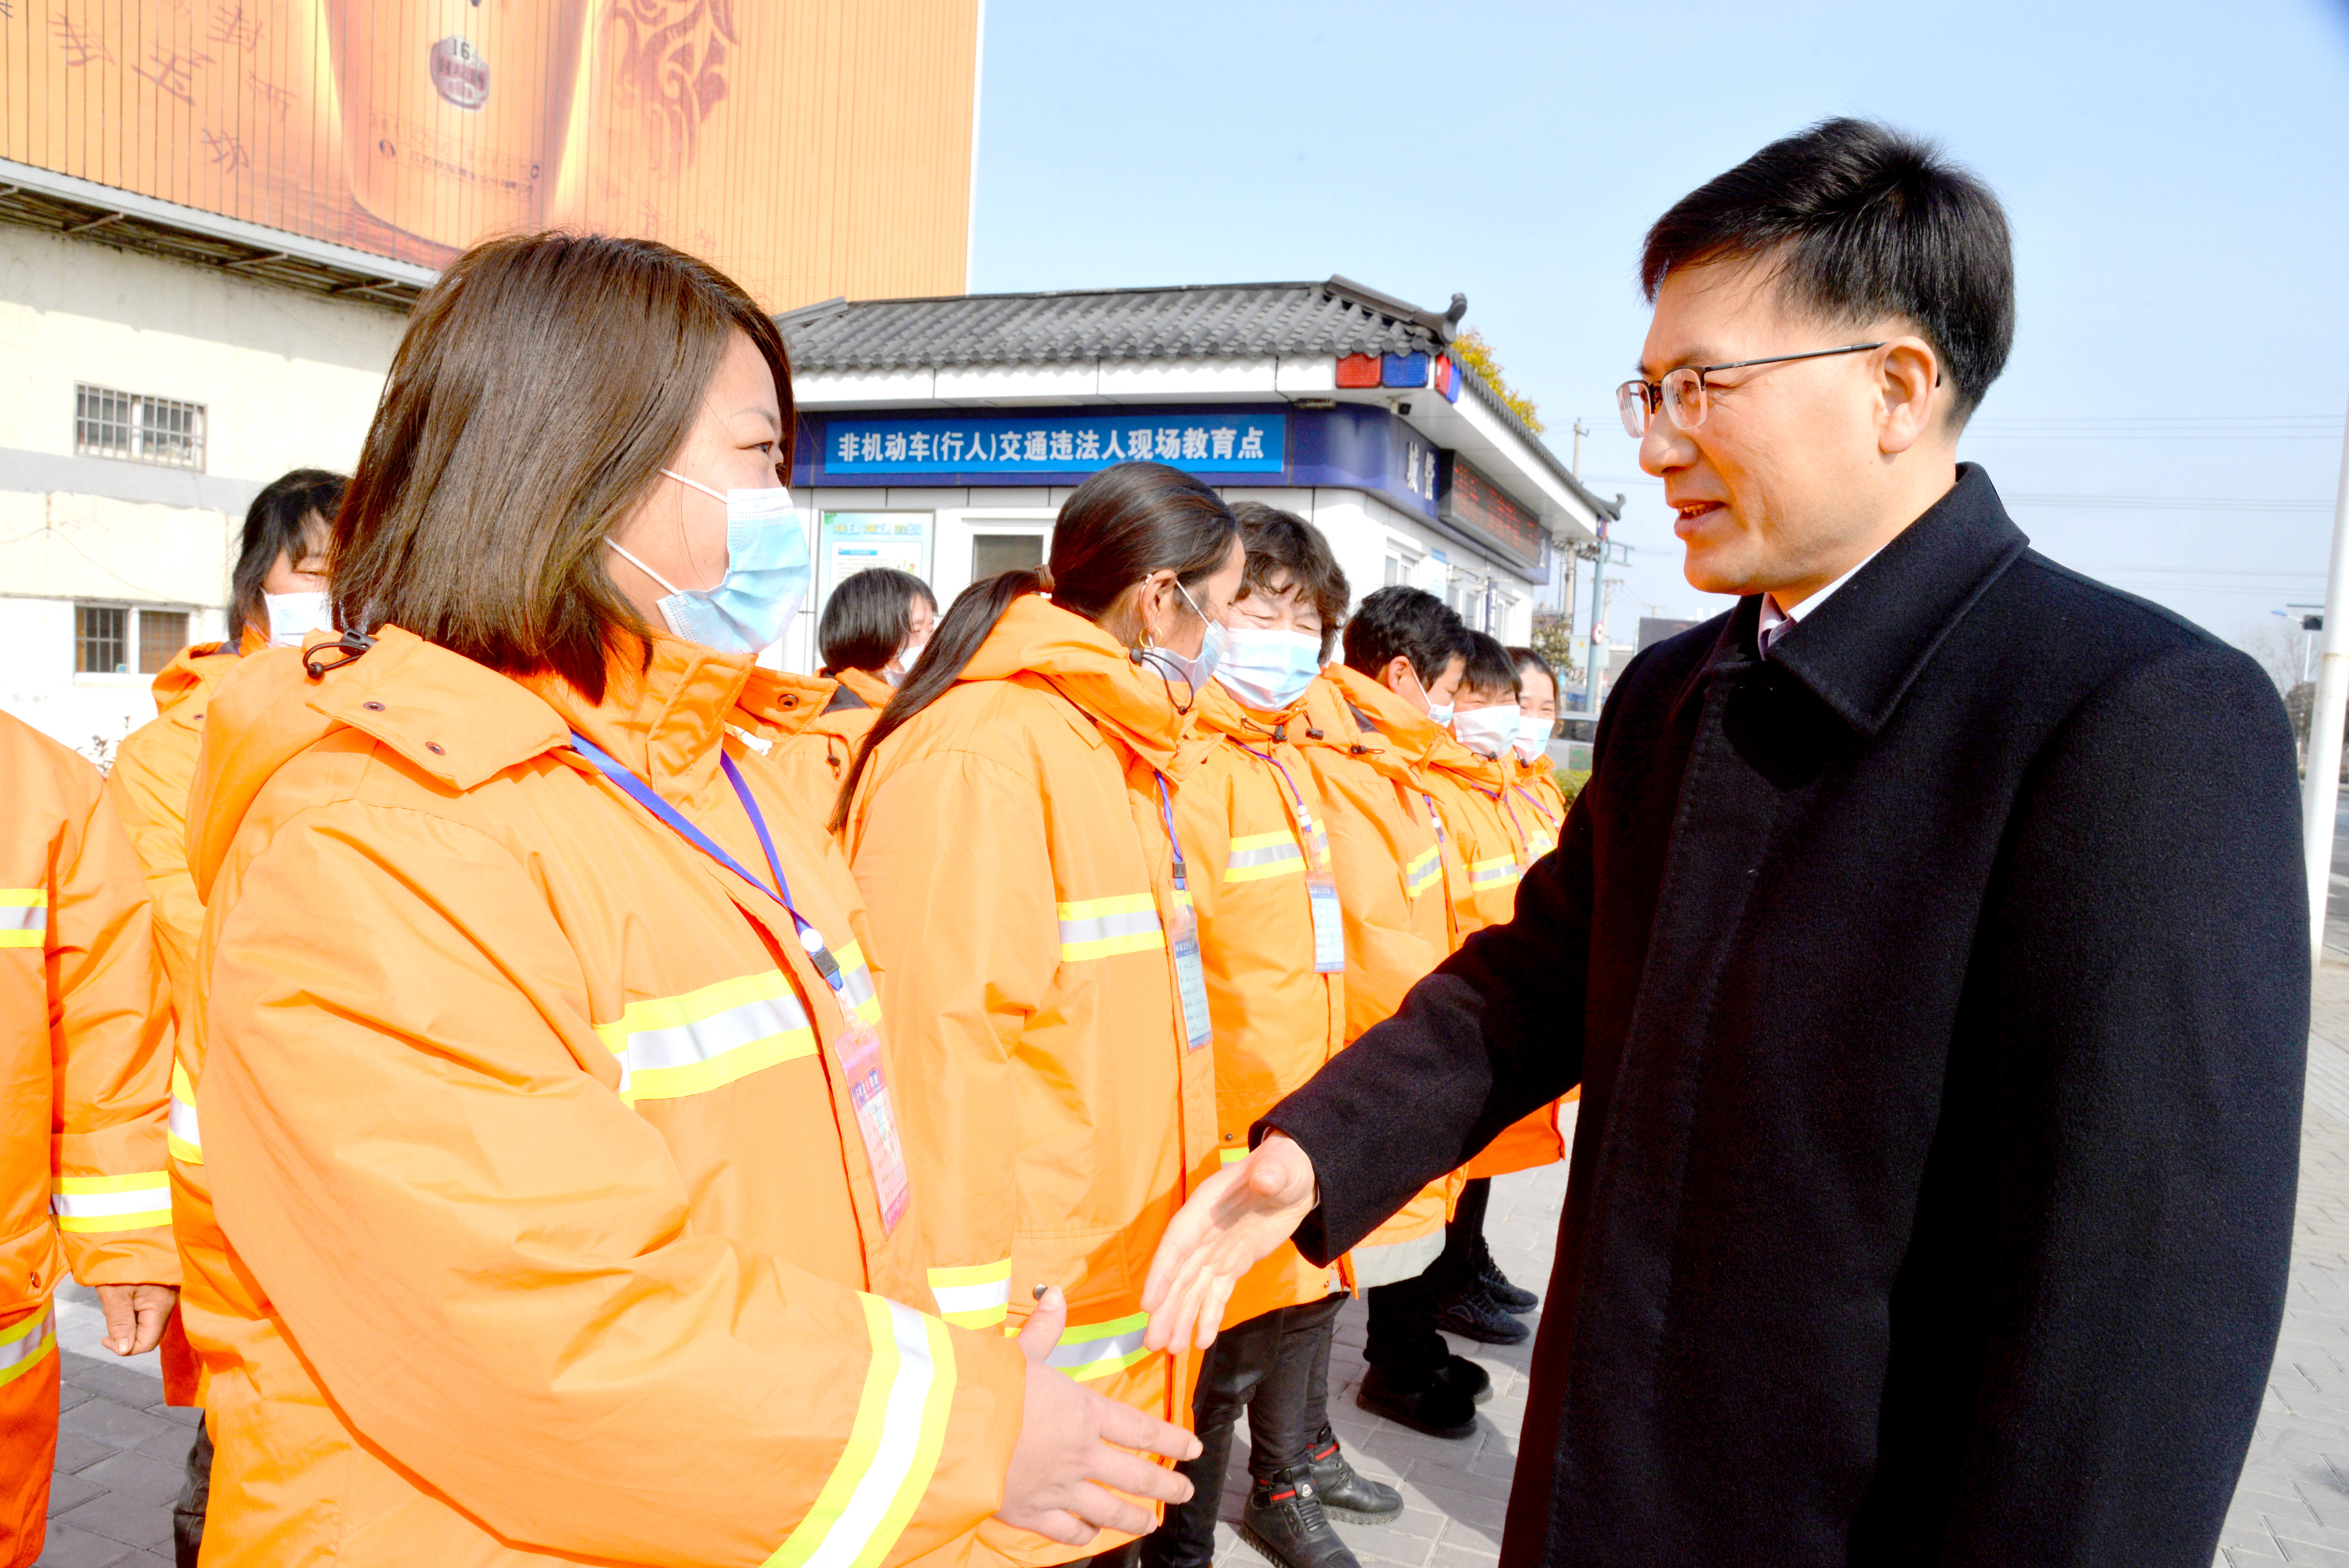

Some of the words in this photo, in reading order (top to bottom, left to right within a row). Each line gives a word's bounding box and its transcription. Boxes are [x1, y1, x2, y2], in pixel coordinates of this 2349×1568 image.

[453, 38, 470, 60] 16
[838, 427, 1264, 461] 非机动车(行人)交通违法人现场教育点
